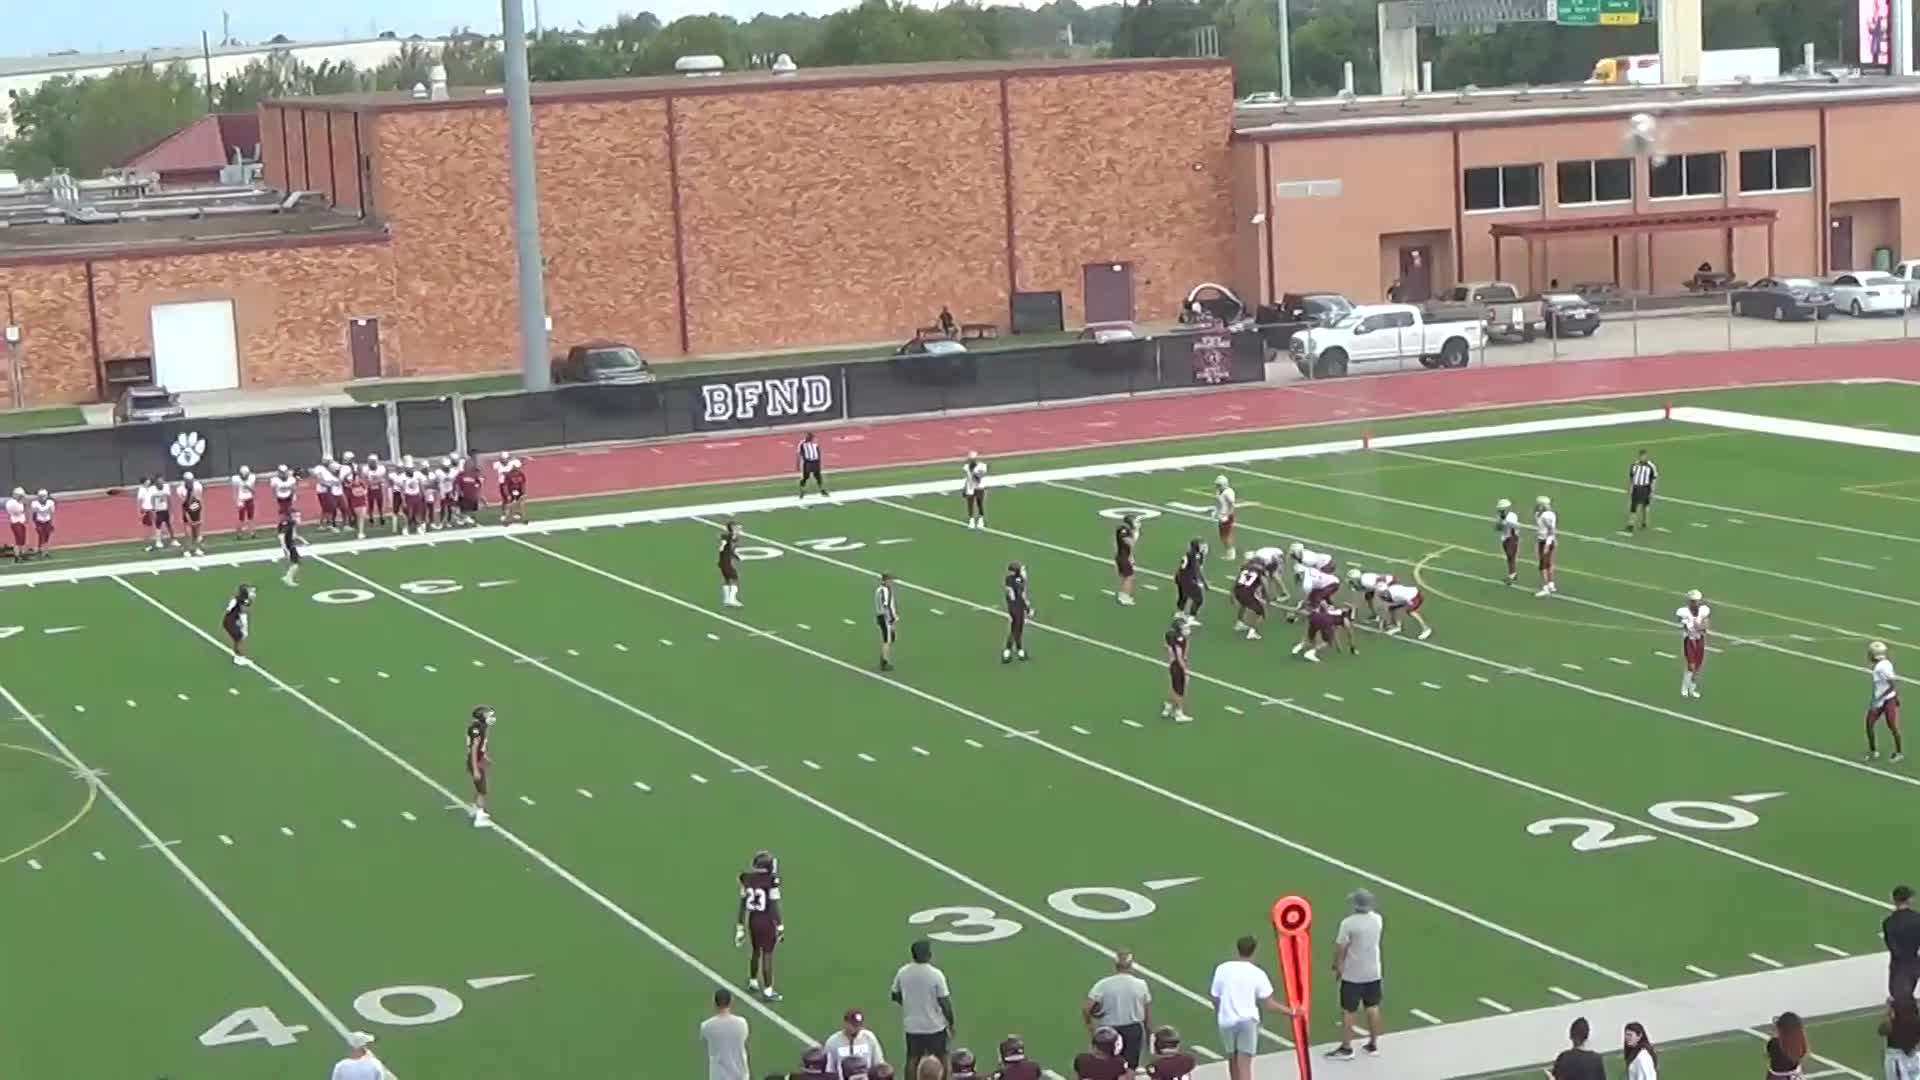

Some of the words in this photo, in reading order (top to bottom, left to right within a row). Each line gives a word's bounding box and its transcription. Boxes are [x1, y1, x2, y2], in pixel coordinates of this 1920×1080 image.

[702, 375, 832, 421] BFND
[1526, 800, 1760, 851] 20
[746, 887, 766, 911] 23
[908, 886, 1156, 942] 30
[199, 985, 463, 1047] 40
